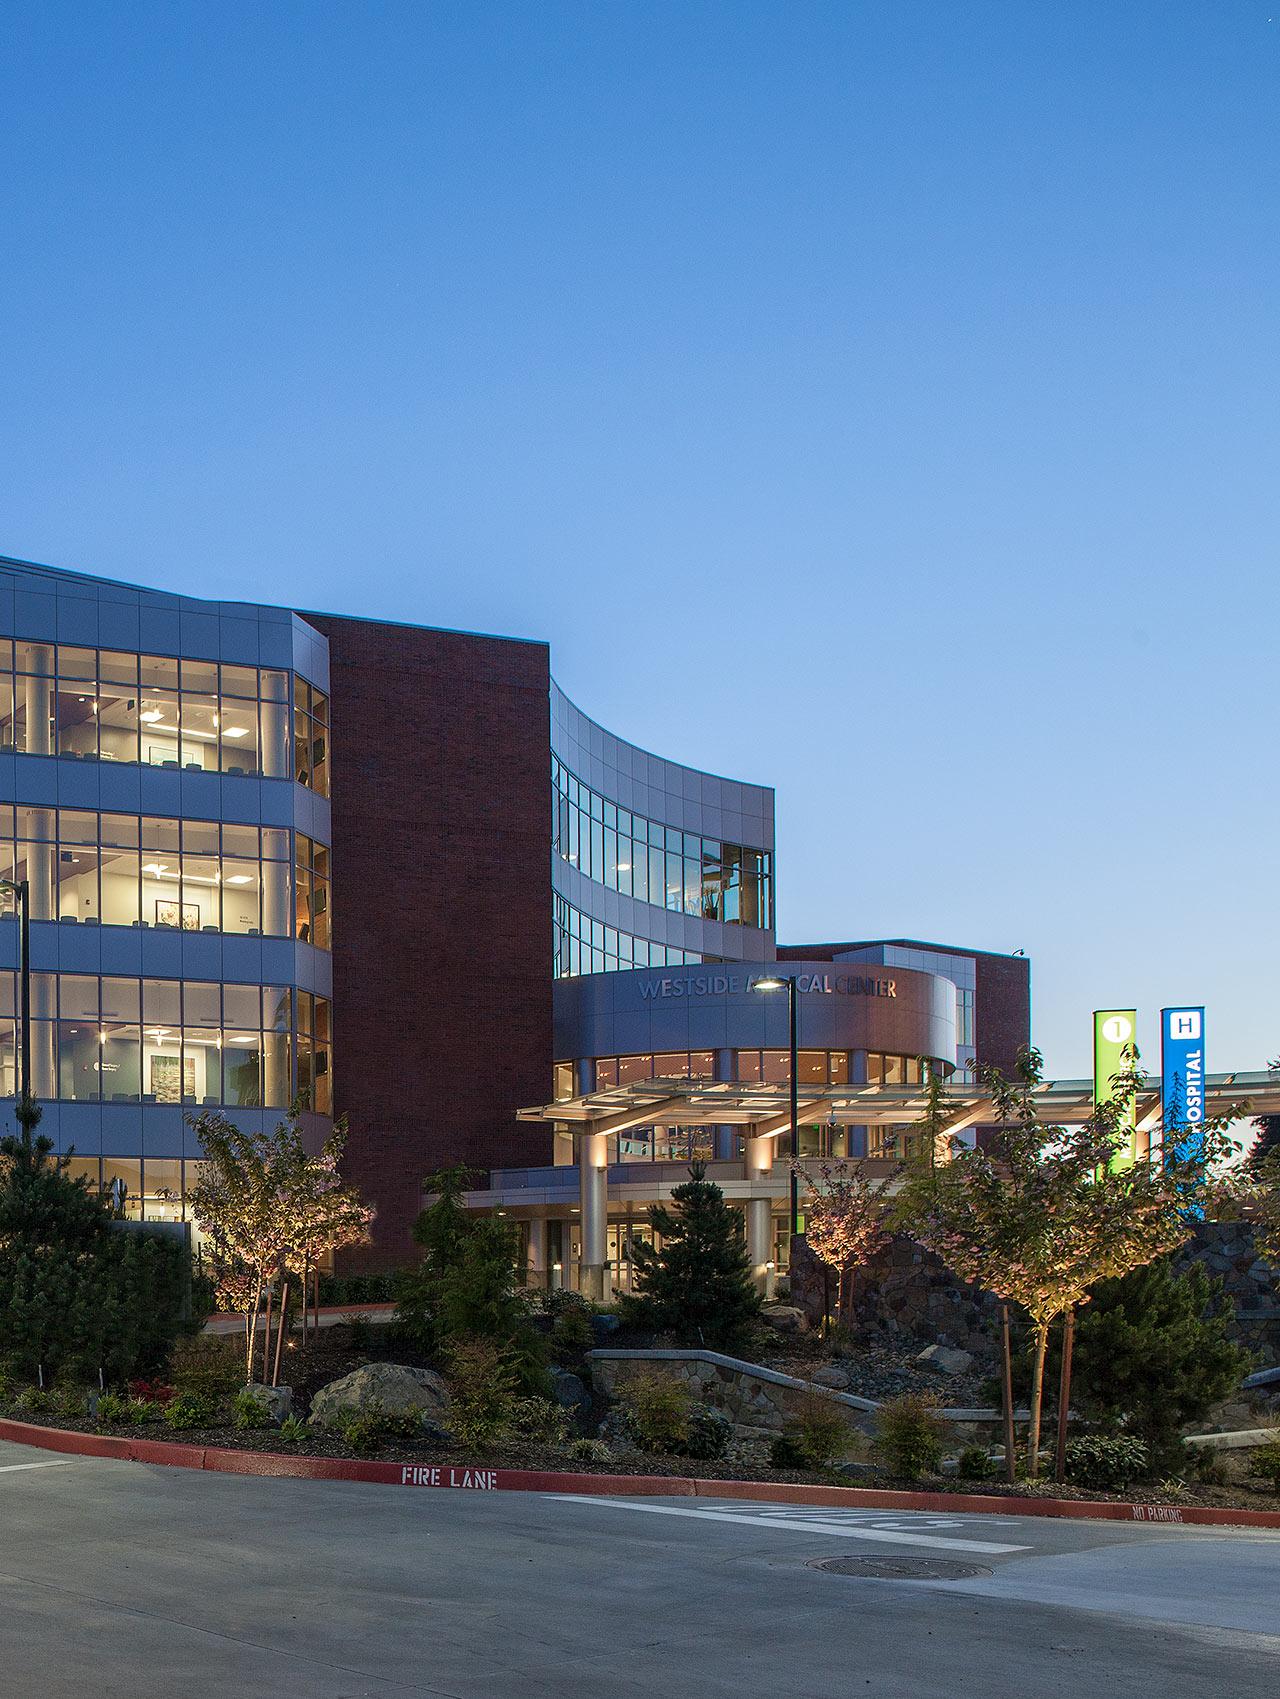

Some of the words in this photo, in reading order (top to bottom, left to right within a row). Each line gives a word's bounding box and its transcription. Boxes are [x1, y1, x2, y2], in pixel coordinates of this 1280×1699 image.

[638, 975, 738, 999] WESTSIDE
[835, 975, 897, 998] CENTER
[402, 1466, 441, 1485] FIRE
[450, 1469, 497, 1490] LANE
[1132, 1505, 1145, 1521] NO
[1147, 1507, 1183, 1522] PARKING
